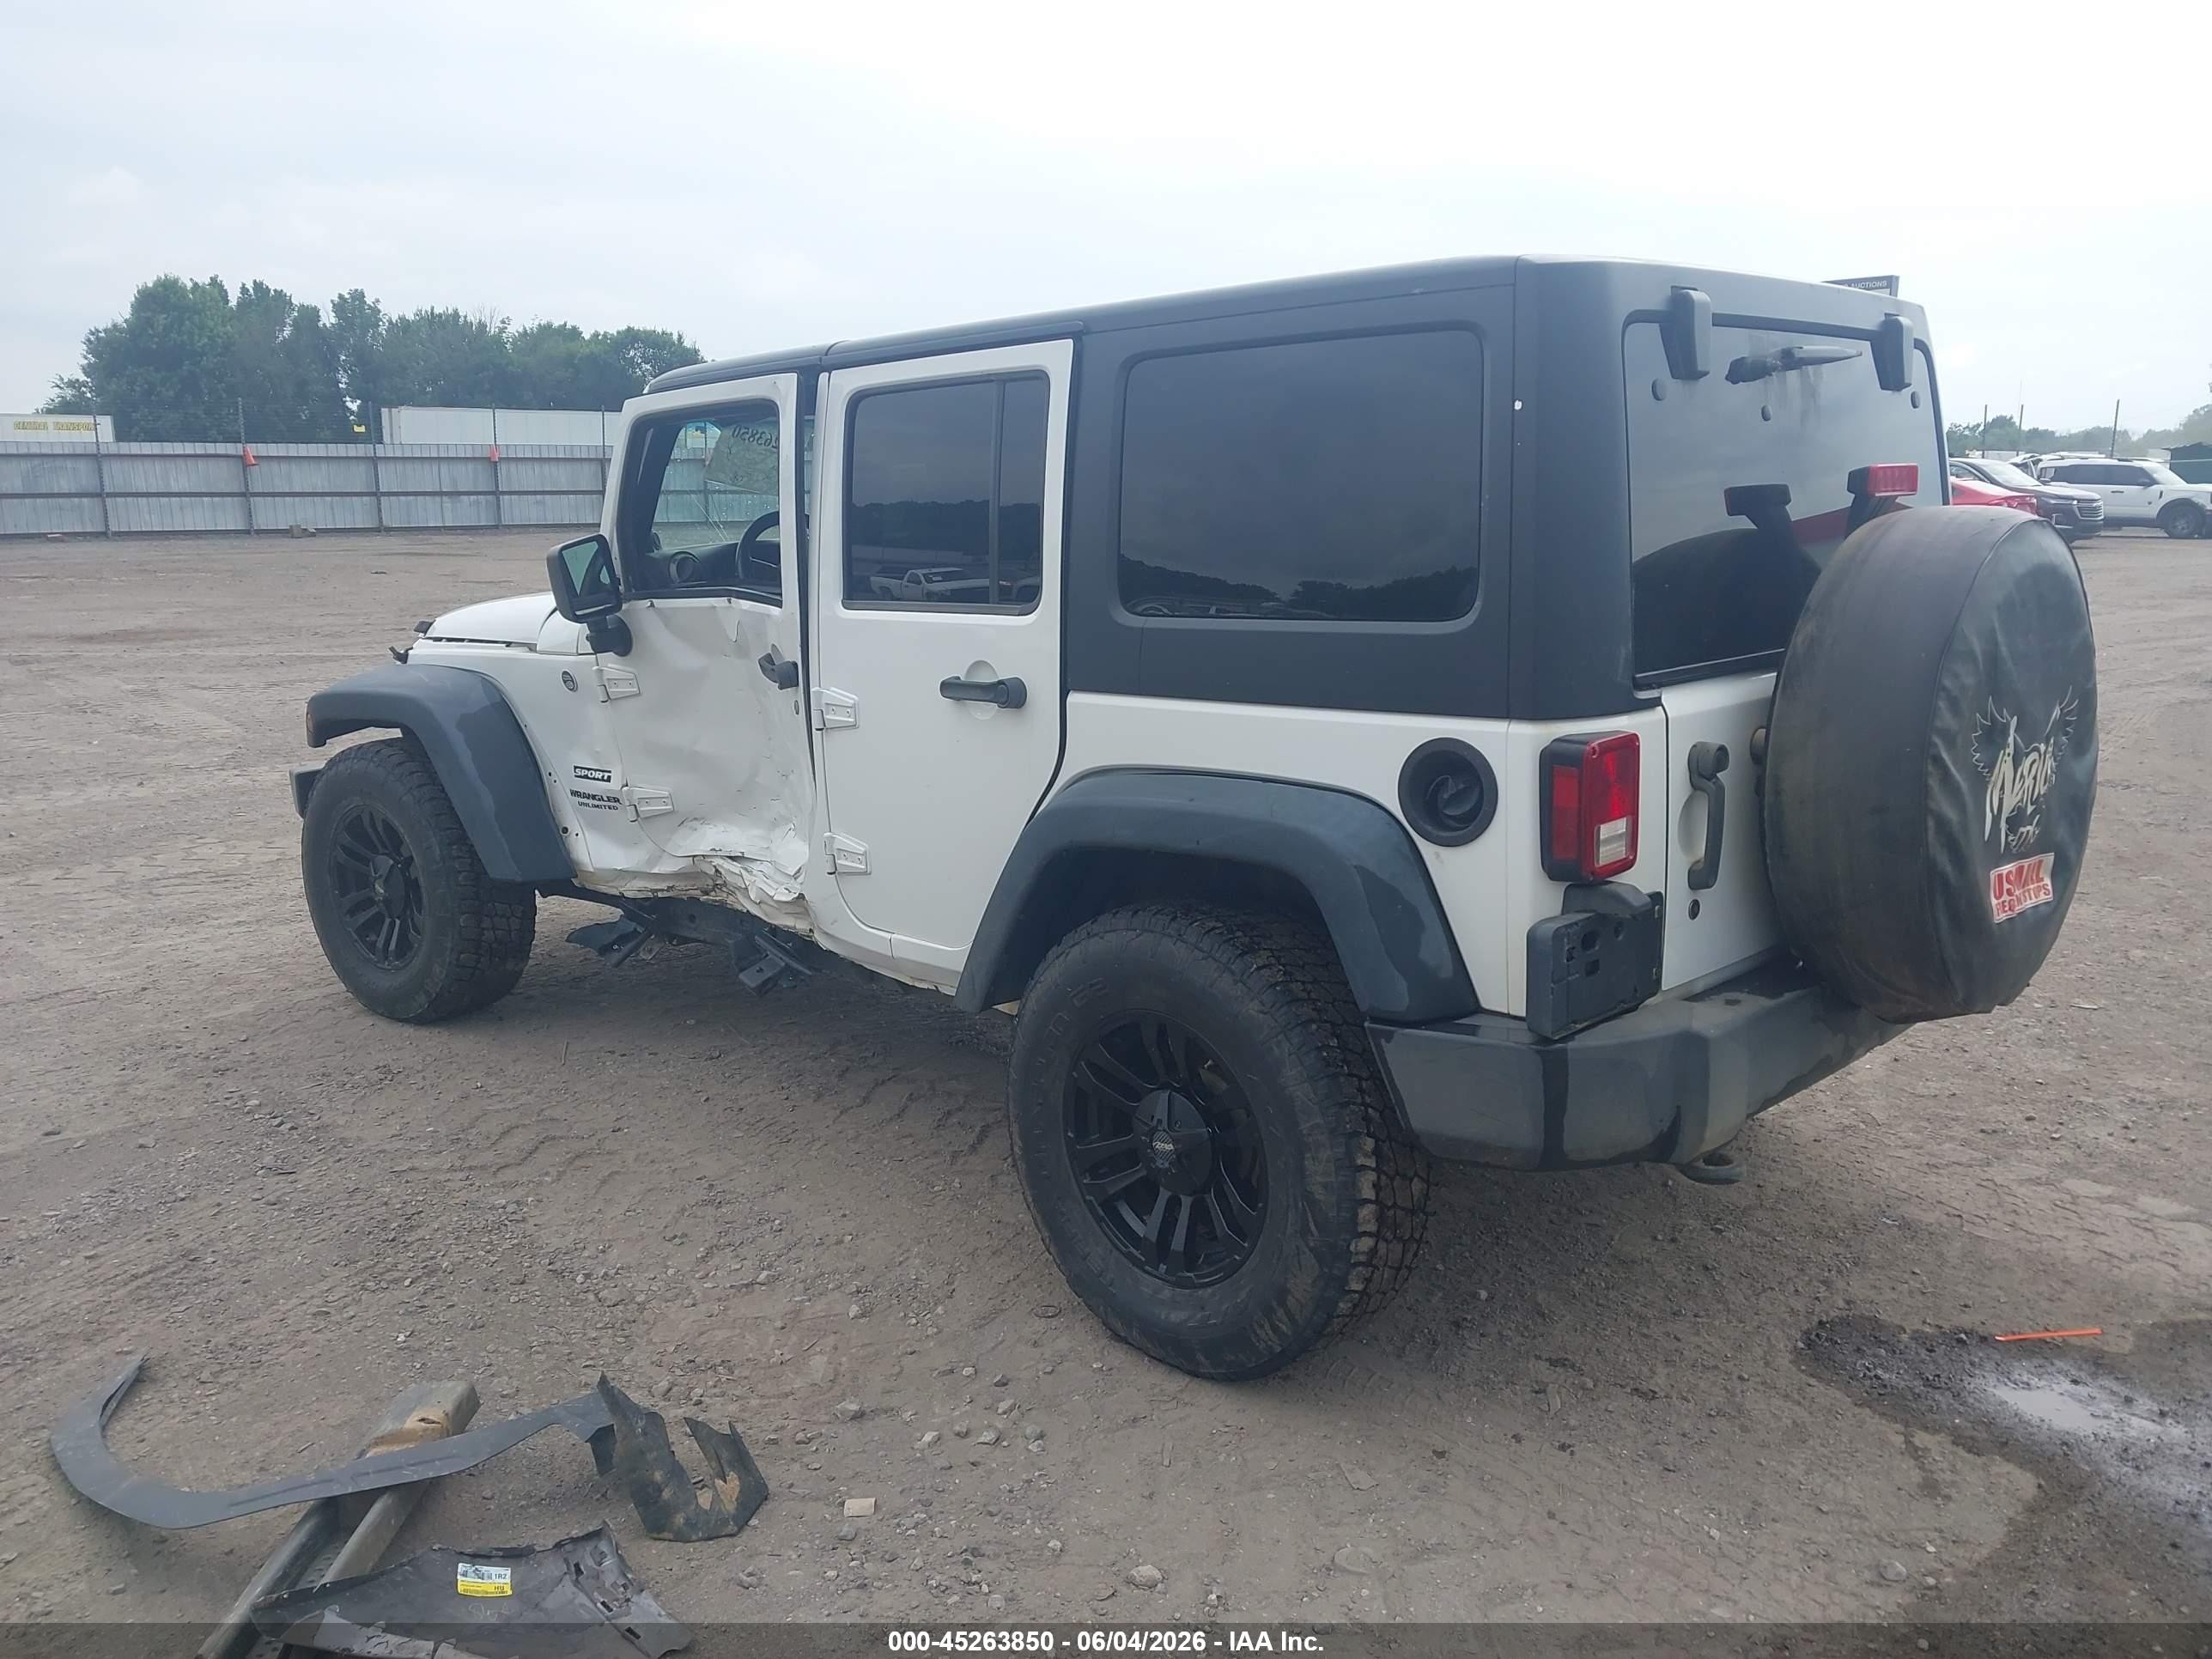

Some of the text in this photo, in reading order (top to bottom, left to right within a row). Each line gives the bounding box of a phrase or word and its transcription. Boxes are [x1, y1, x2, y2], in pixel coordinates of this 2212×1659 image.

[575, 768, 611, 781] SPORT
[569, 788, 623, 805] WRANGLER
[577, 800, 618, 811] UNLIMITED
